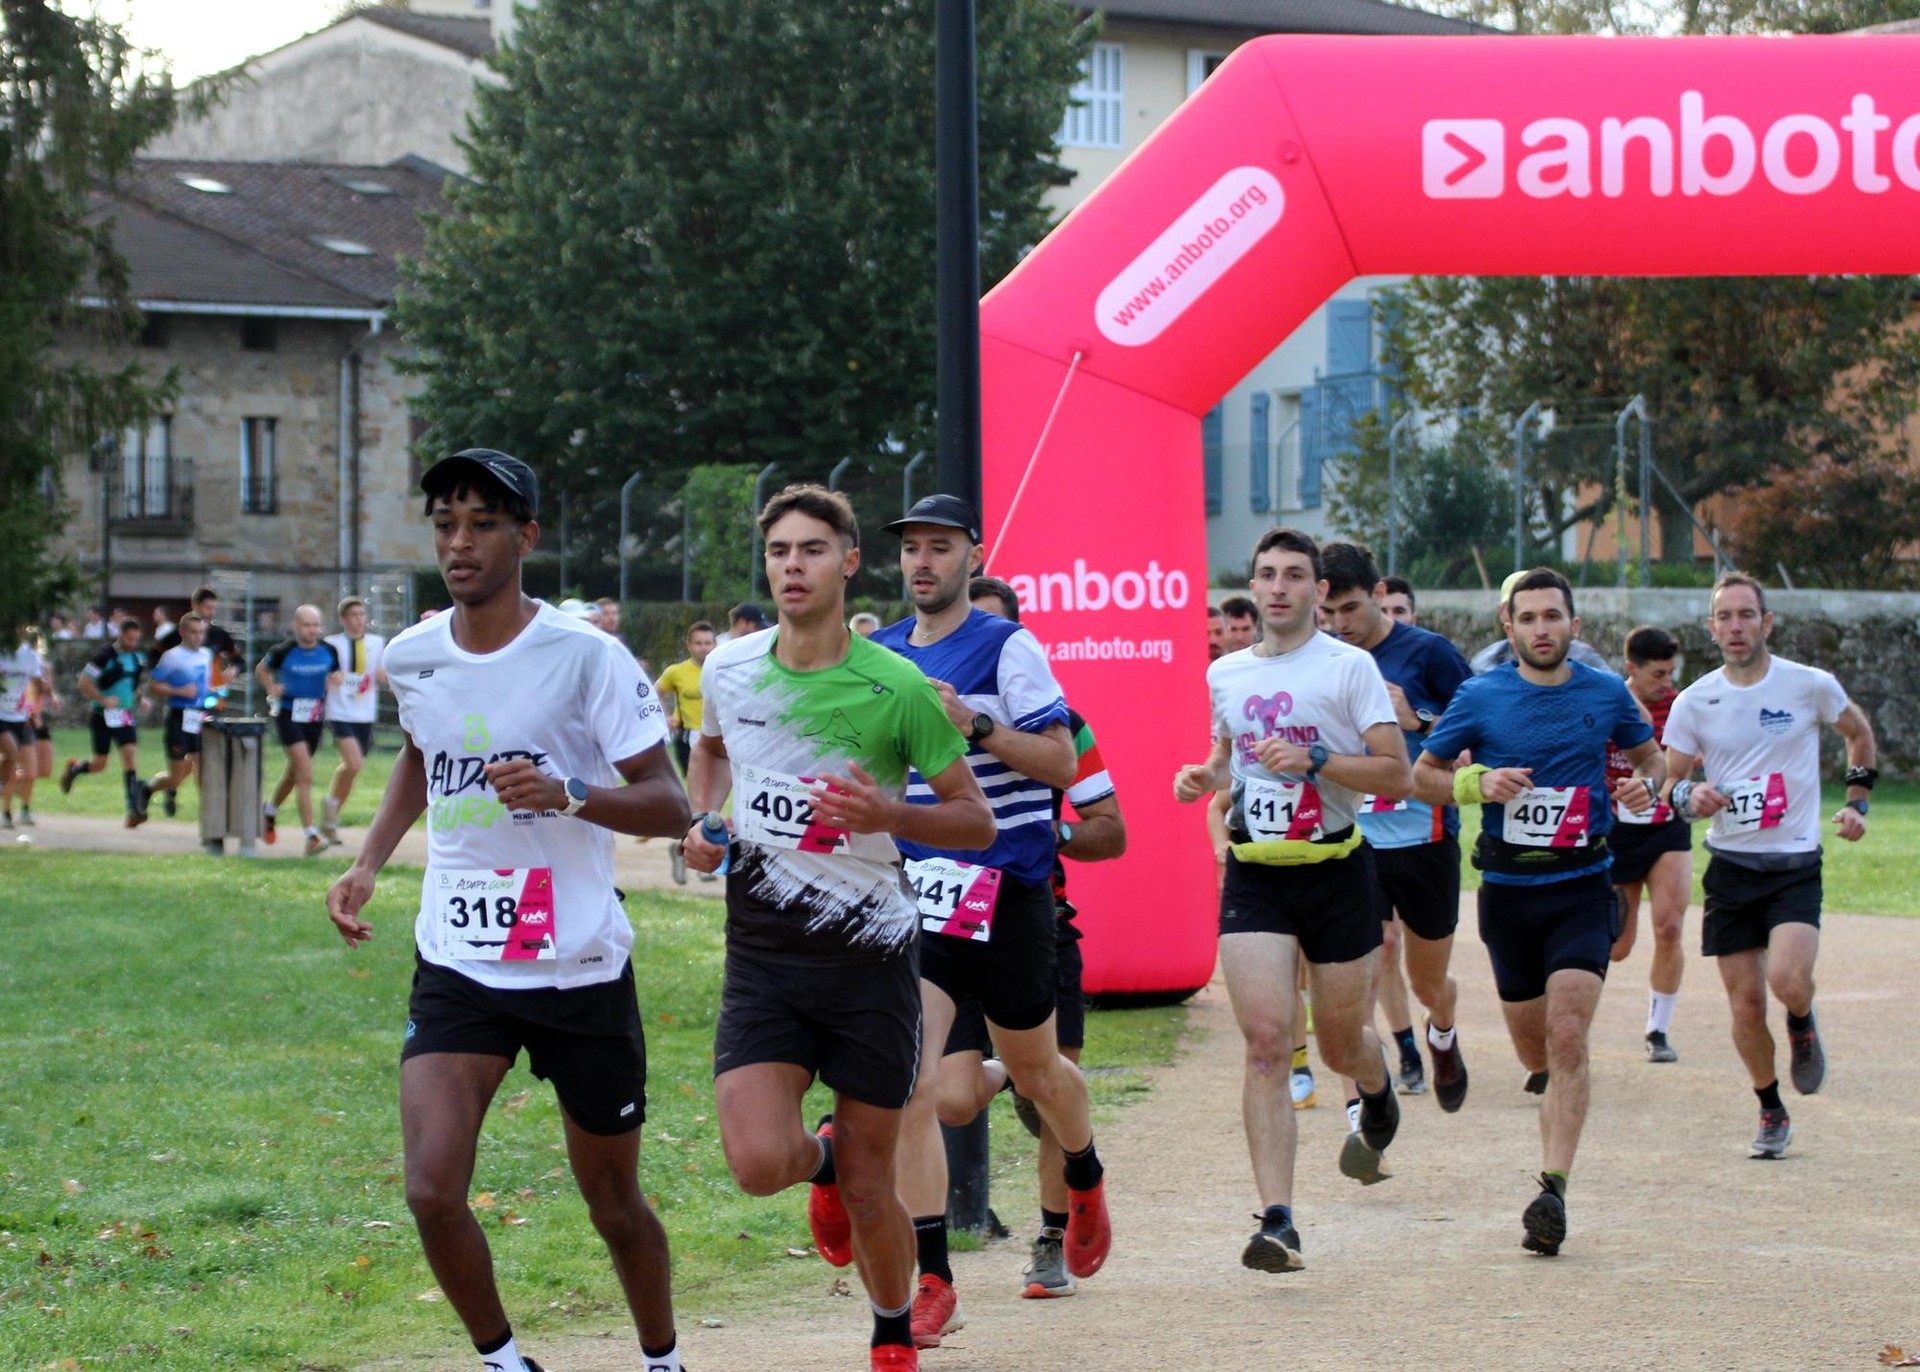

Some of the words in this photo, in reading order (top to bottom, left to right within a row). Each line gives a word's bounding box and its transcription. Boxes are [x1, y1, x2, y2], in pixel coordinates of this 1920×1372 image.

[1112, 185, 1267, 328] www.anboto.org
[1018, 558, 1189, 613] anboto
[750, 791, 816, 827] 402
[1249, 798, 1294, 823] 411
[1513, 804, 1566, 827] 407
[1727, 792, 1767, 816] 473
[448, 896, 519, 928] 318
